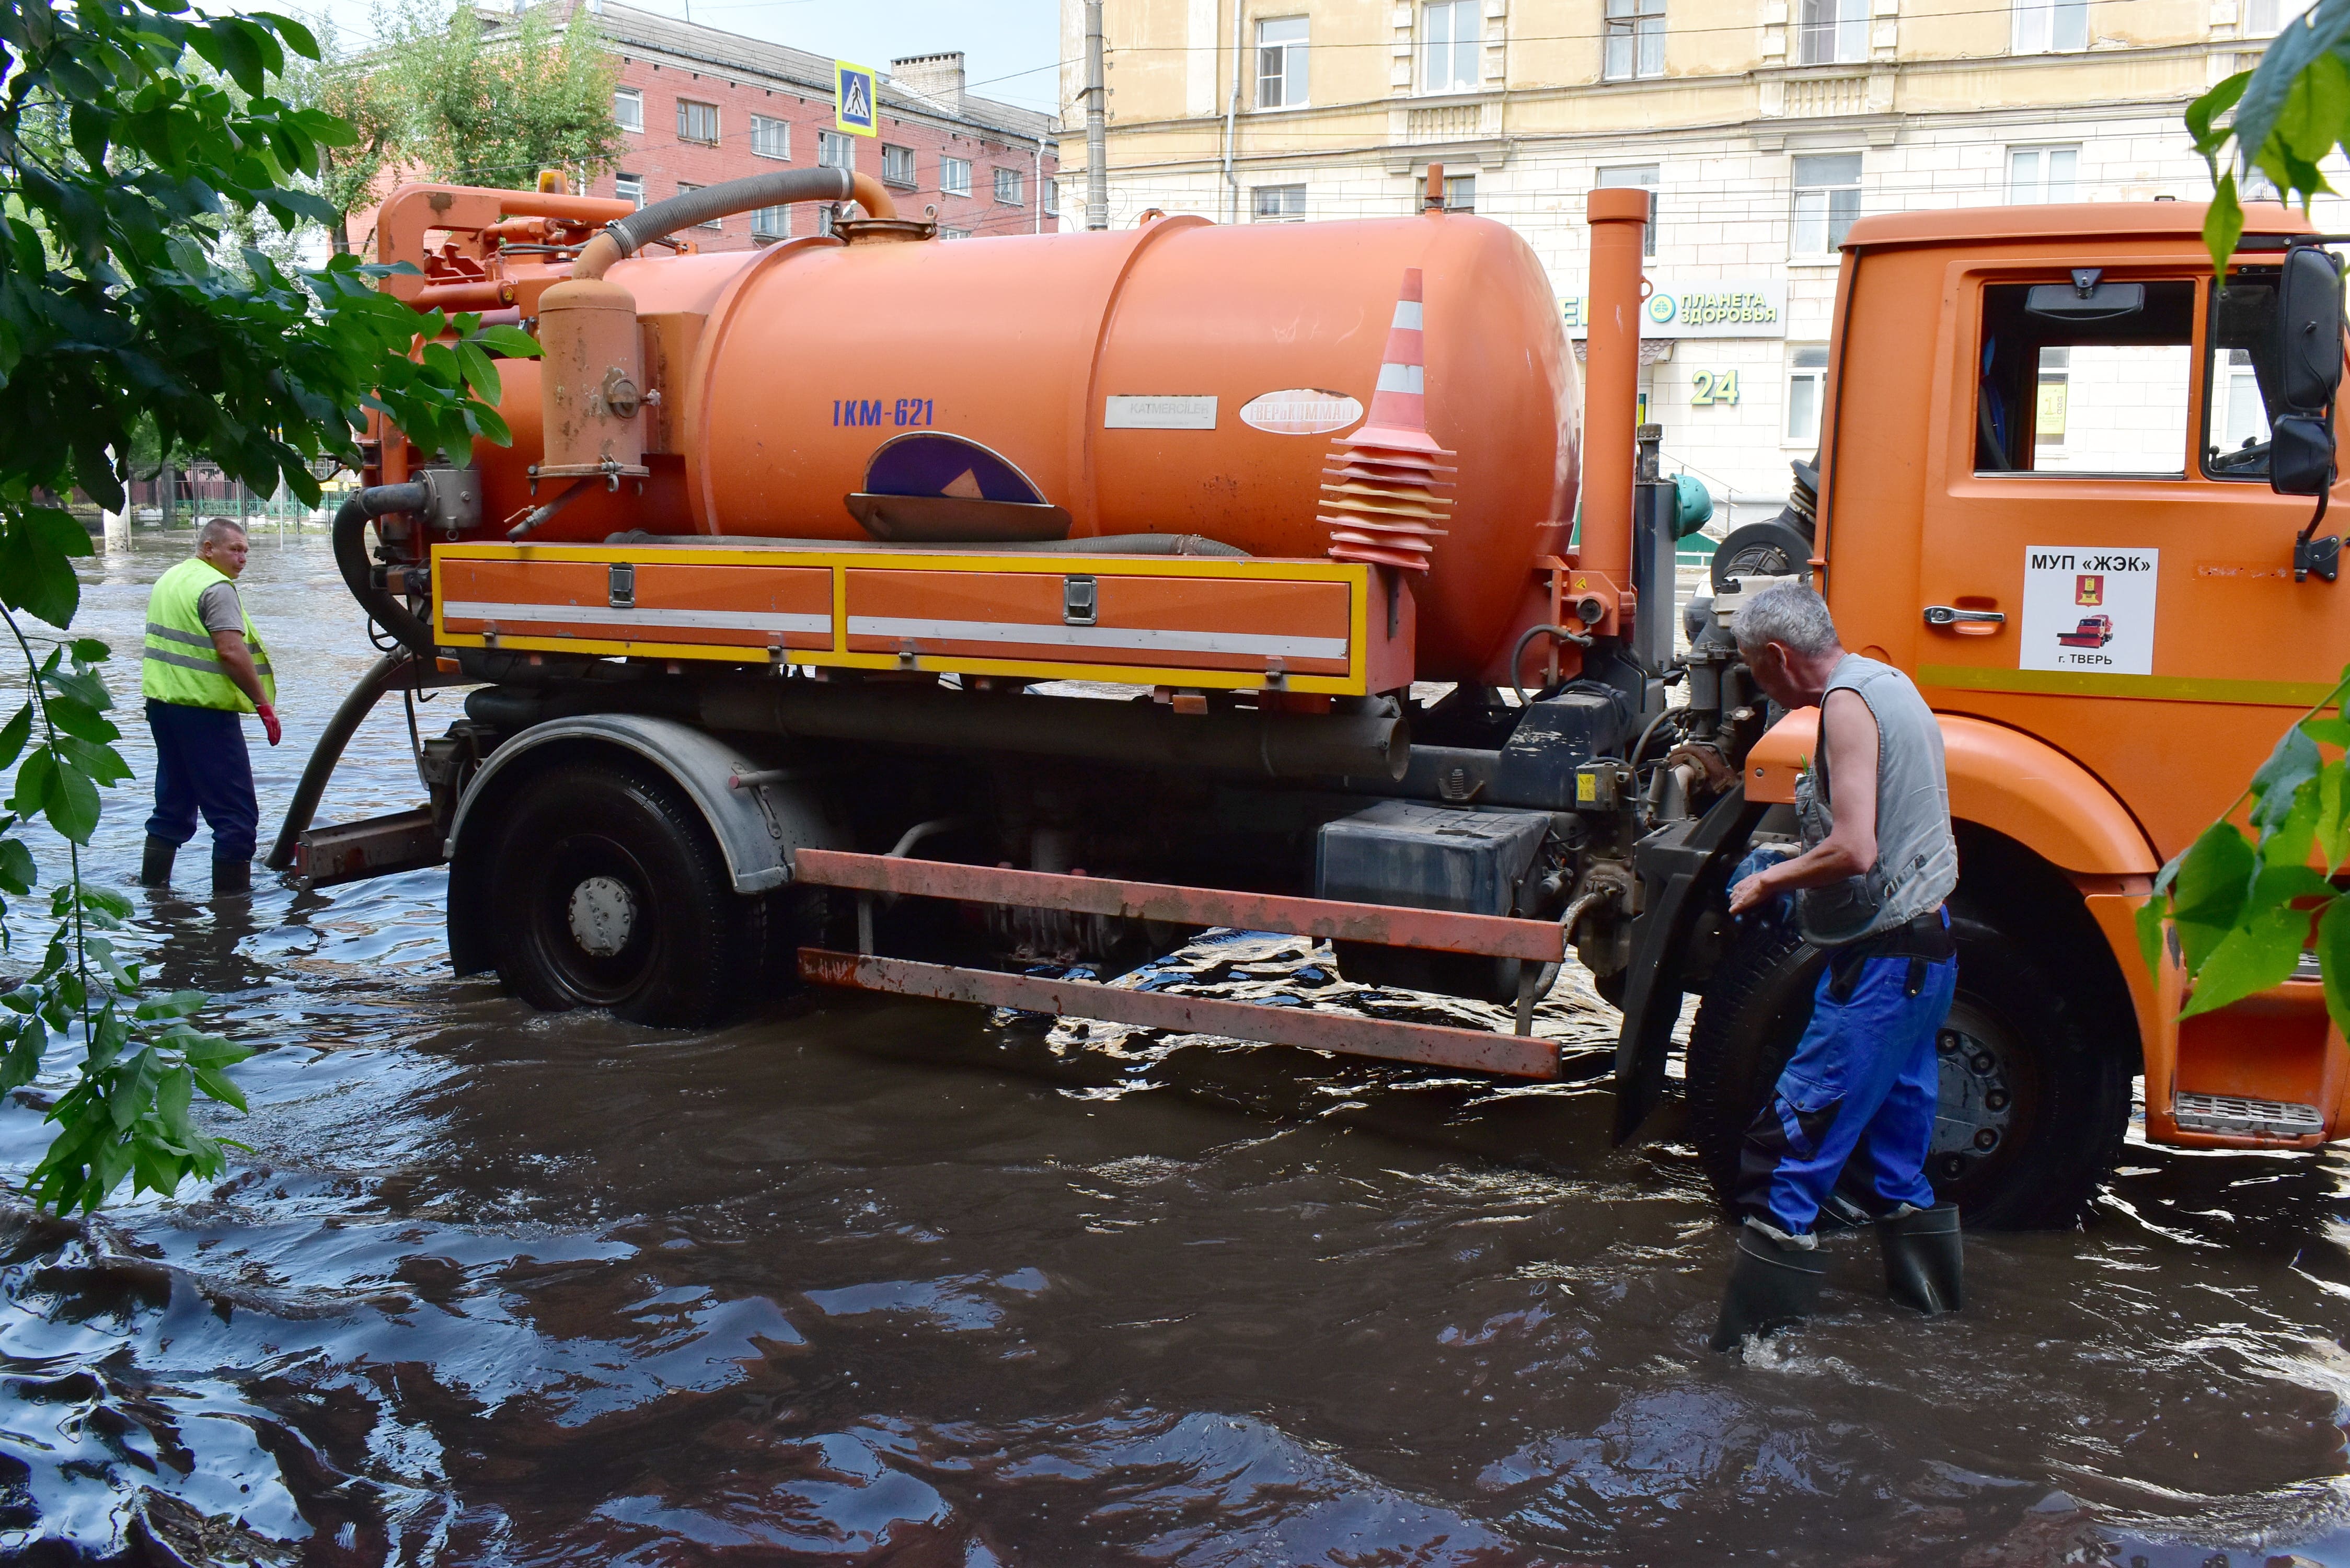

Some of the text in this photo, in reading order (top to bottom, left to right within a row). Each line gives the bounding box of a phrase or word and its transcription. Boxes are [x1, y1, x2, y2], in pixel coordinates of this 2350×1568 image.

[1681, 293, 1766, 308] ПЛАНЕТА
[1680, 307, 1777, 326] ЗДОРОВЬЯ
[1690, 370, 1740, 405] 24
[833, 398, 933, 426] ТКМ-621
[2032, 555, 2151, 572] МУП «ЖЭК»
[2069, 654, 2113, 665] ТВЕРЬ
